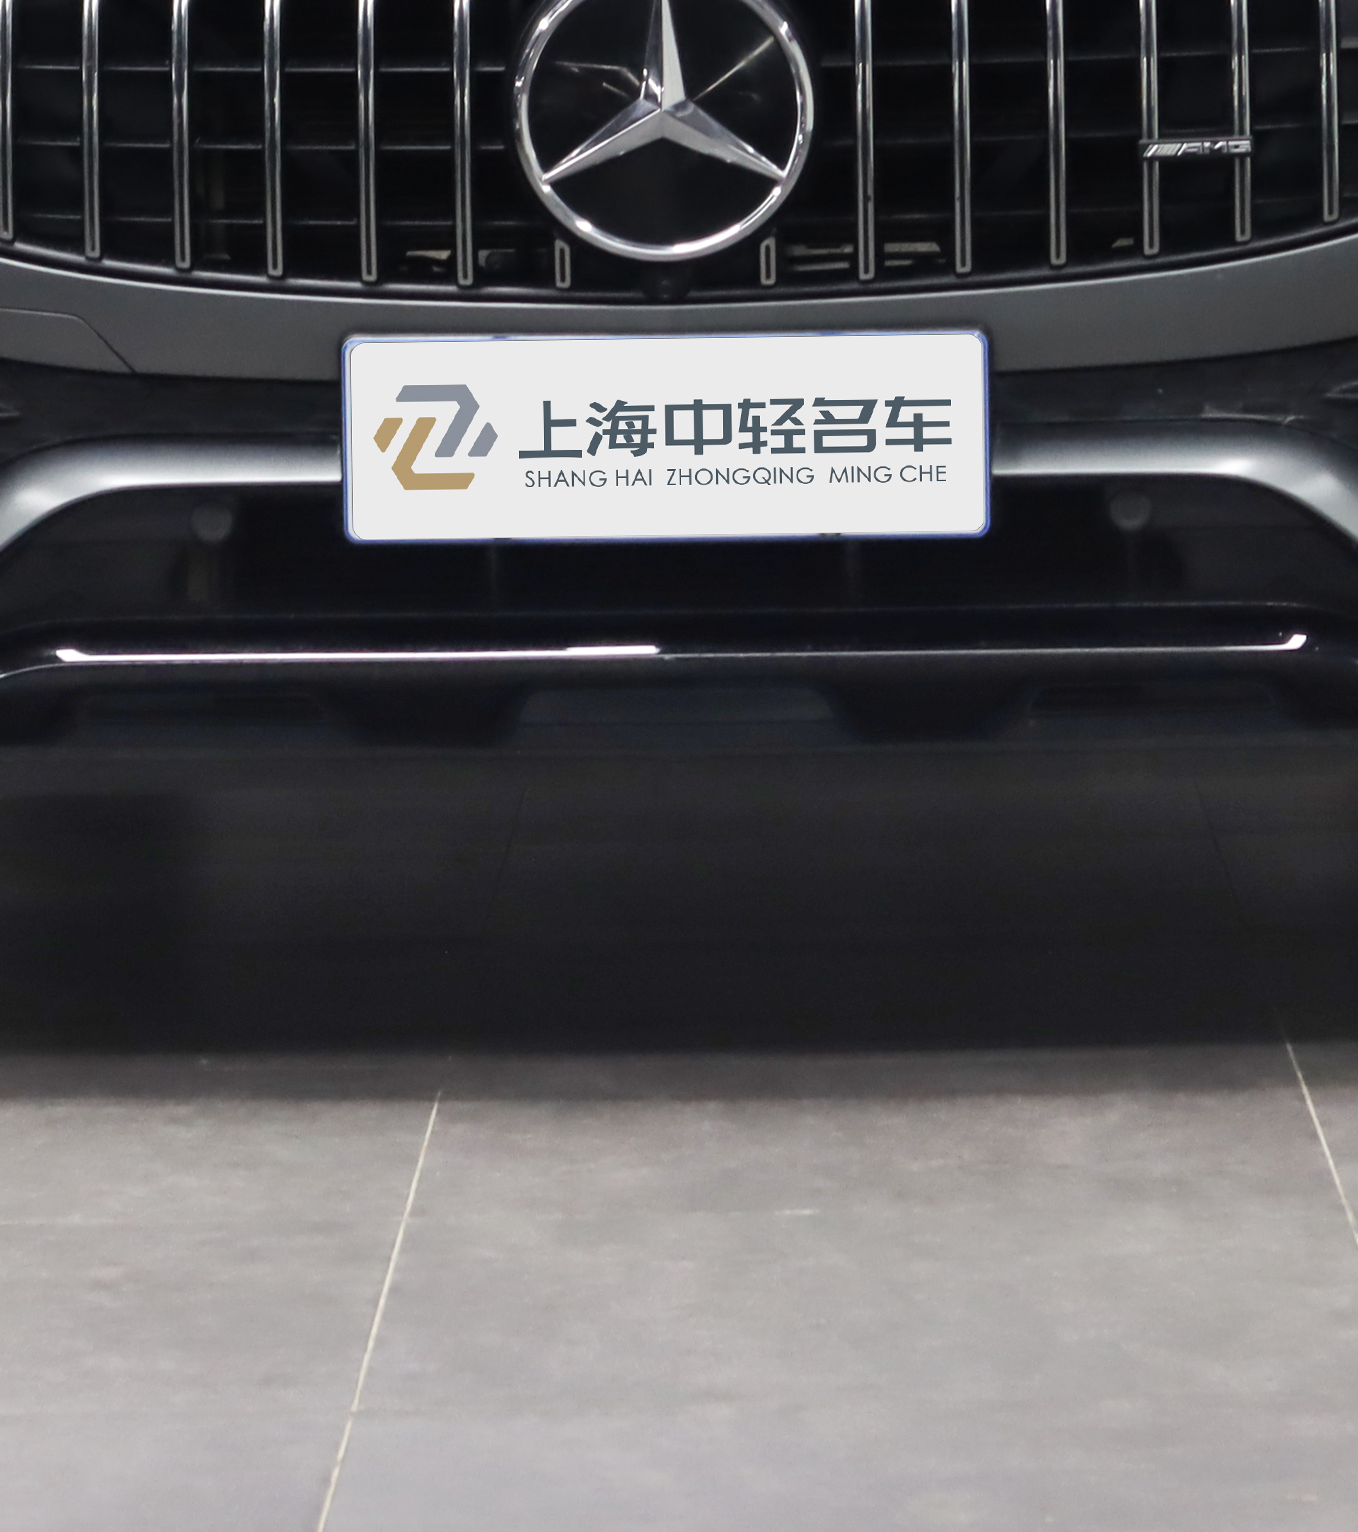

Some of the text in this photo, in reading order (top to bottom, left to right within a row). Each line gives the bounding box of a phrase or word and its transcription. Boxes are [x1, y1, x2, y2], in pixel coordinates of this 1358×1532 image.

[519, 396, 952, 459] 上海中轻名车
[525, 465, 946, 487] SHANG HAI ZHONGQING MING CHE
